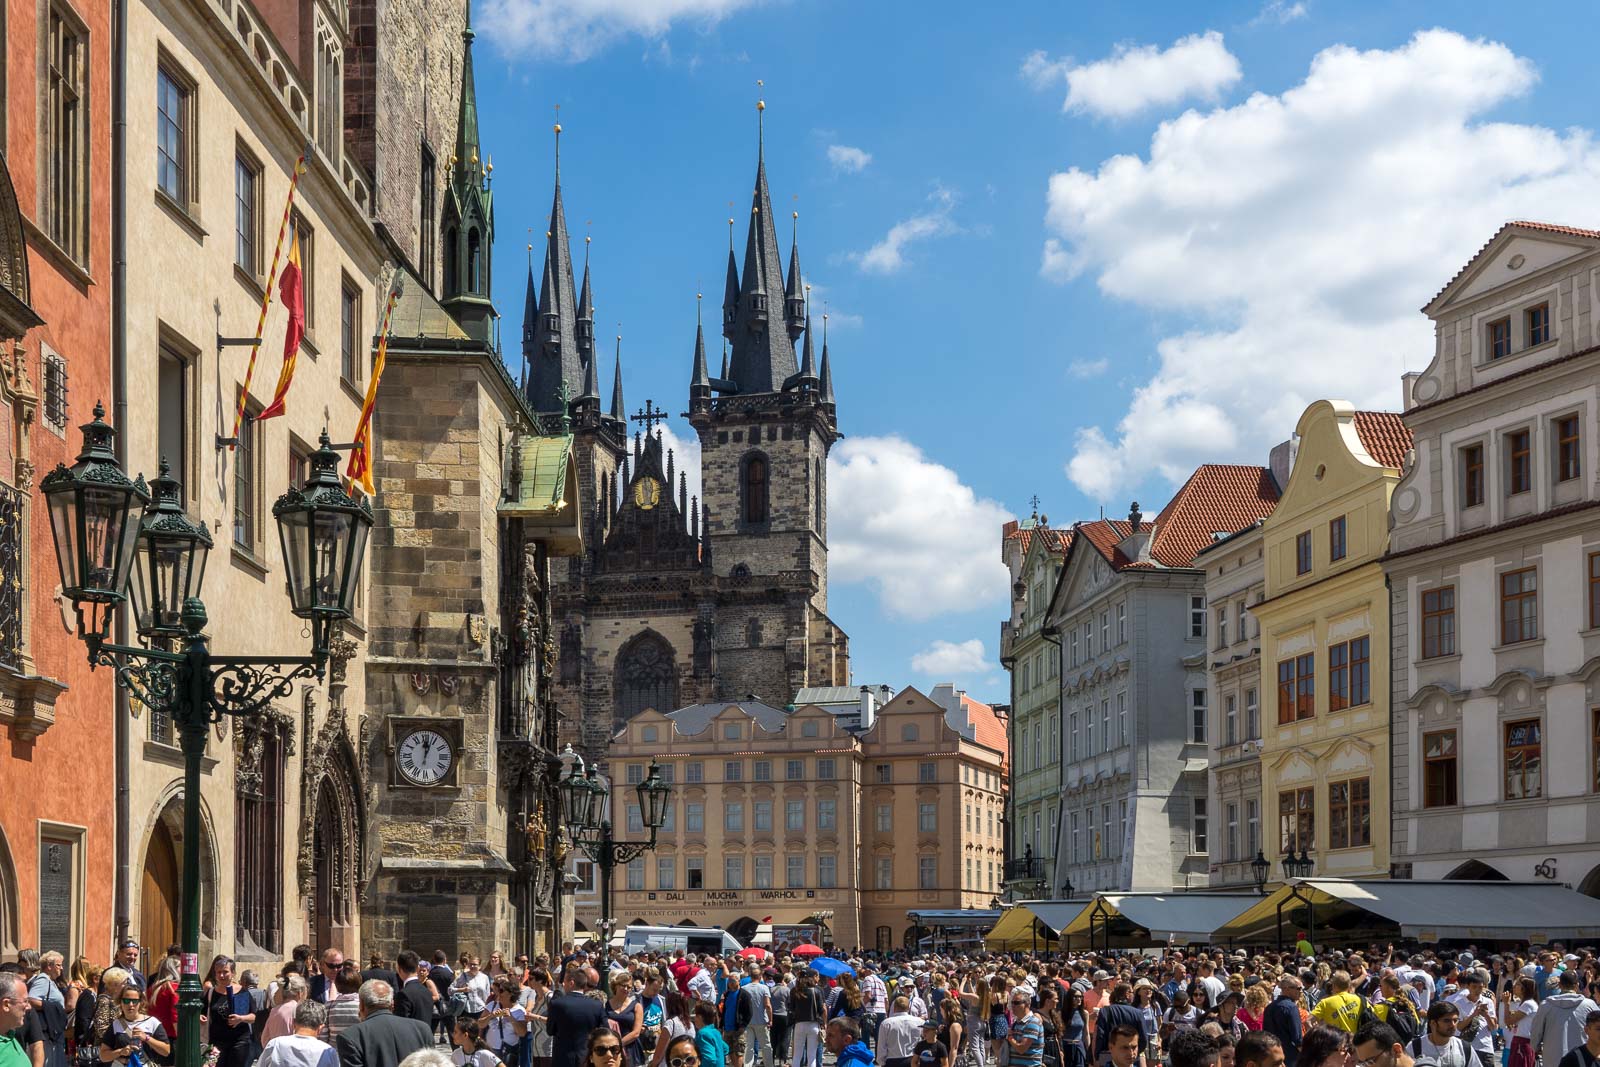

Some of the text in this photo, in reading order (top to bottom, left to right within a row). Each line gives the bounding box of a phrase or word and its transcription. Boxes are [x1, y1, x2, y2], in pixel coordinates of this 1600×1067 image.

[666, 891, 797, 901] DALI MUCHA WARHOL
